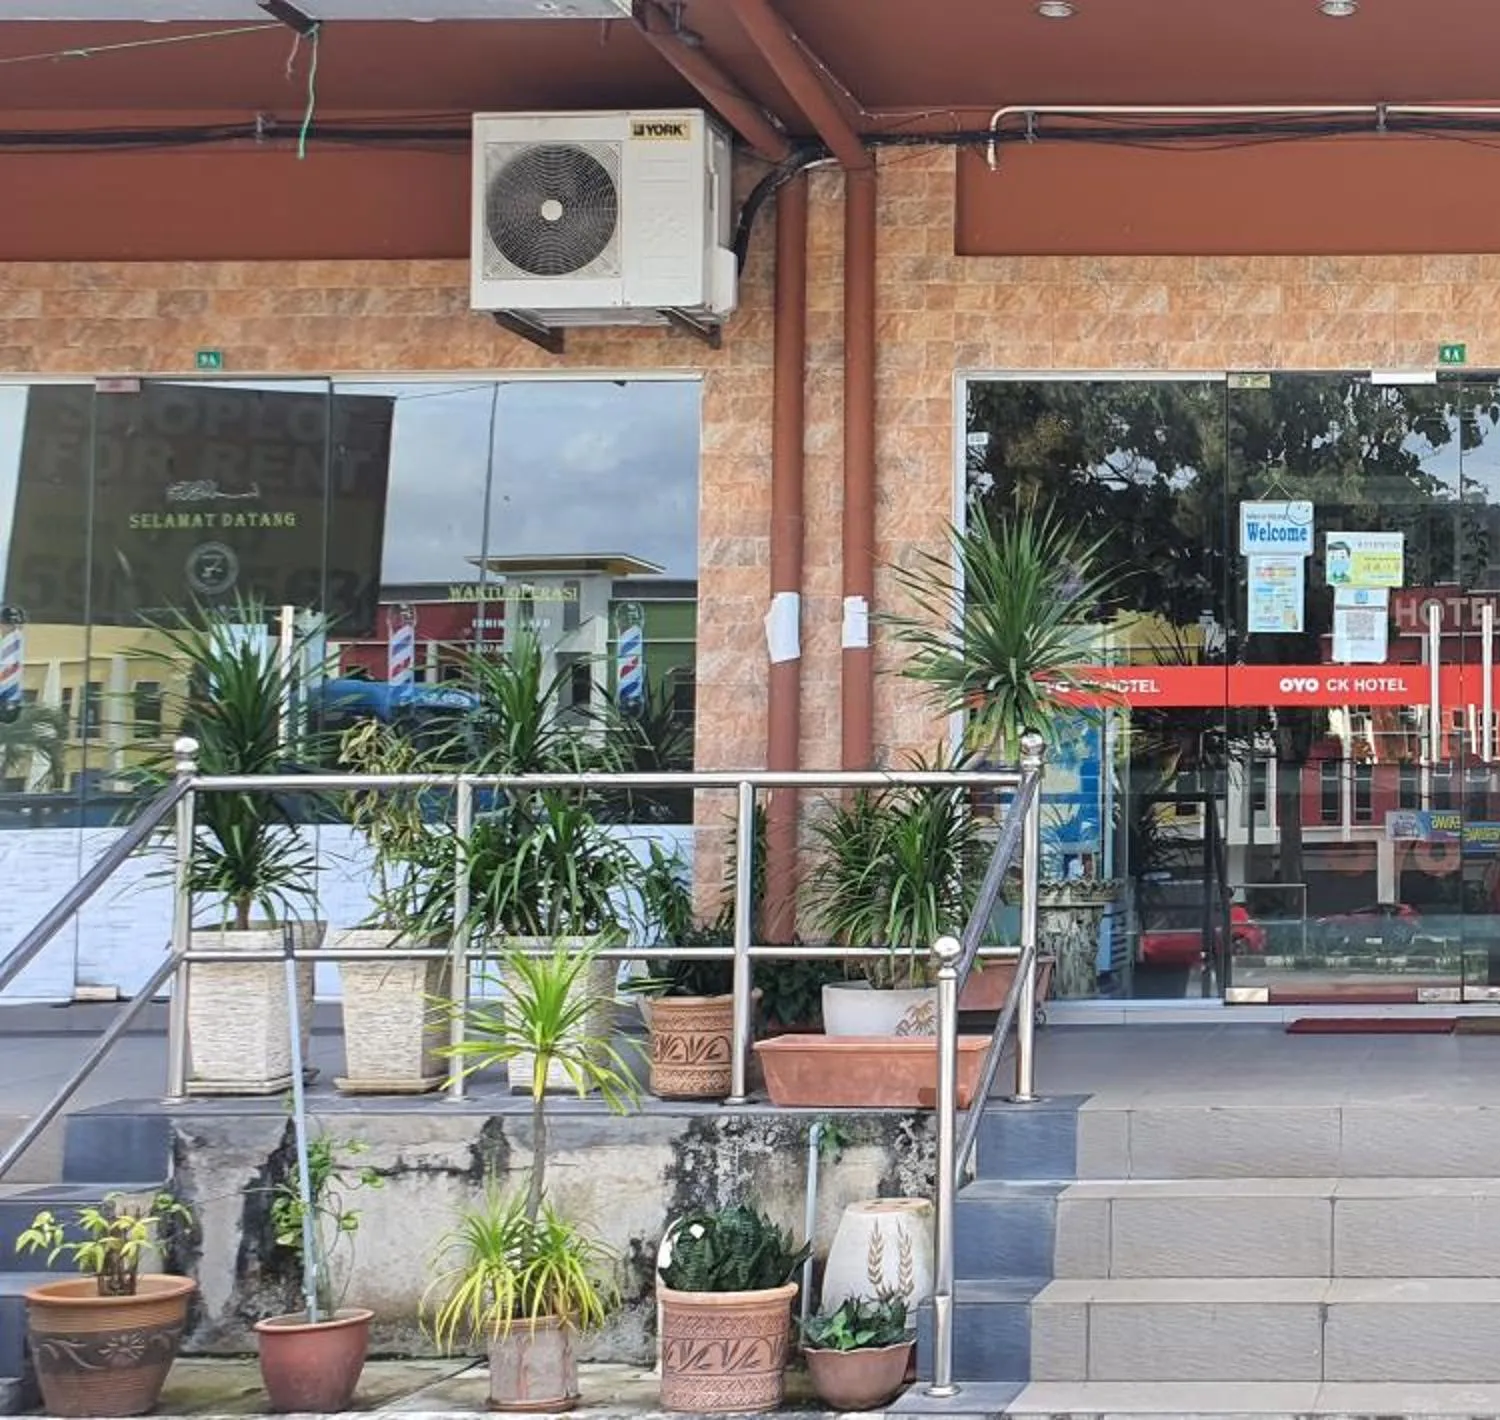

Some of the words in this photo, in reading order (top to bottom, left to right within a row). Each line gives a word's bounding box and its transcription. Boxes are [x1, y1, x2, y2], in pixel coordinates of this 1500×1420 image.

[645, 123, 684, 137] YORK
[199, 440, 371, 494] RENT
[129, 513, 215, 529] SELAMAT
[221, 511, 297, 528] DATANG
[1247, 521, 1308, 542] Welcome
[1279, 678, 1319, 693] OYO
[1326, 678, 1350, 692] CK
[1353, 677, 1408, 692] HOTEL
